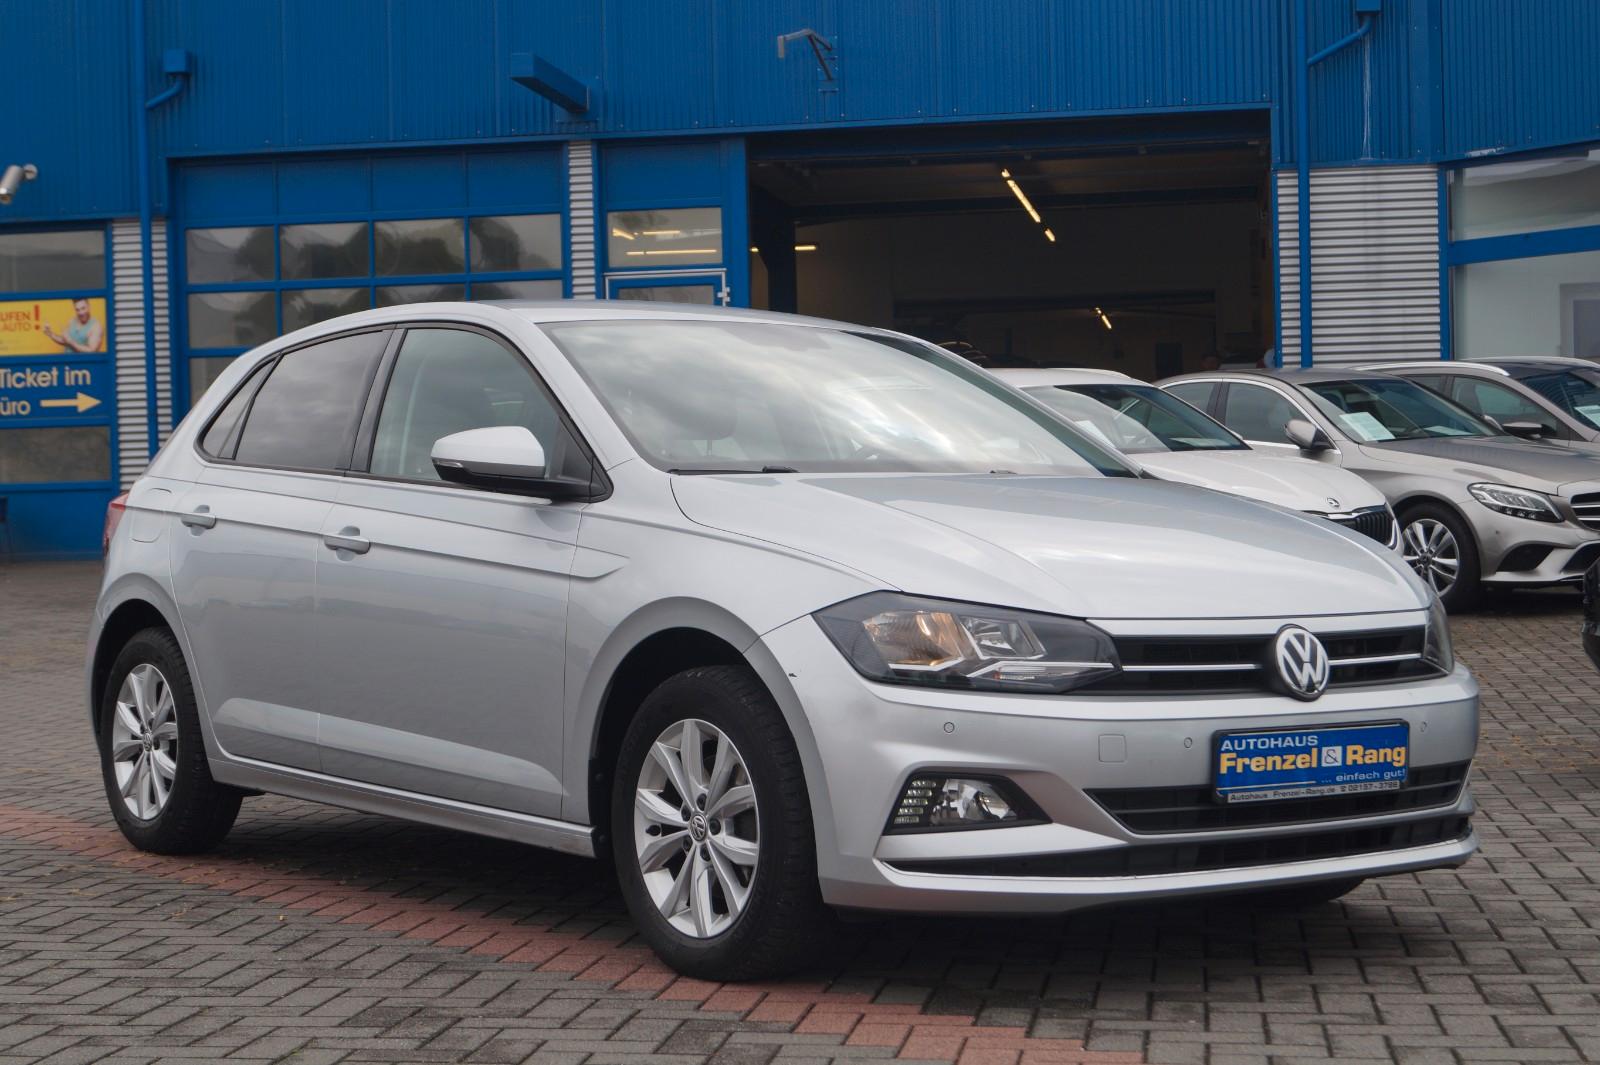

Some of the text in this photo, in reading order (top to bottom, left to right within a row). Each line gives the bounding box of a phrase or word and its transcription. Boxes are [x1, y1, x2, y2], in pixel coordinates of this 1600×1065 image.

[0, 365, 91, 389] Ticket im
[1221, 735, 1318, 751] AUTOHAUS
[1219, 744, 1407, 775] Frenzel & Rang
[1335, 770, 1381, 782] einfach
[1383, 768, 1407, 780] gut!
